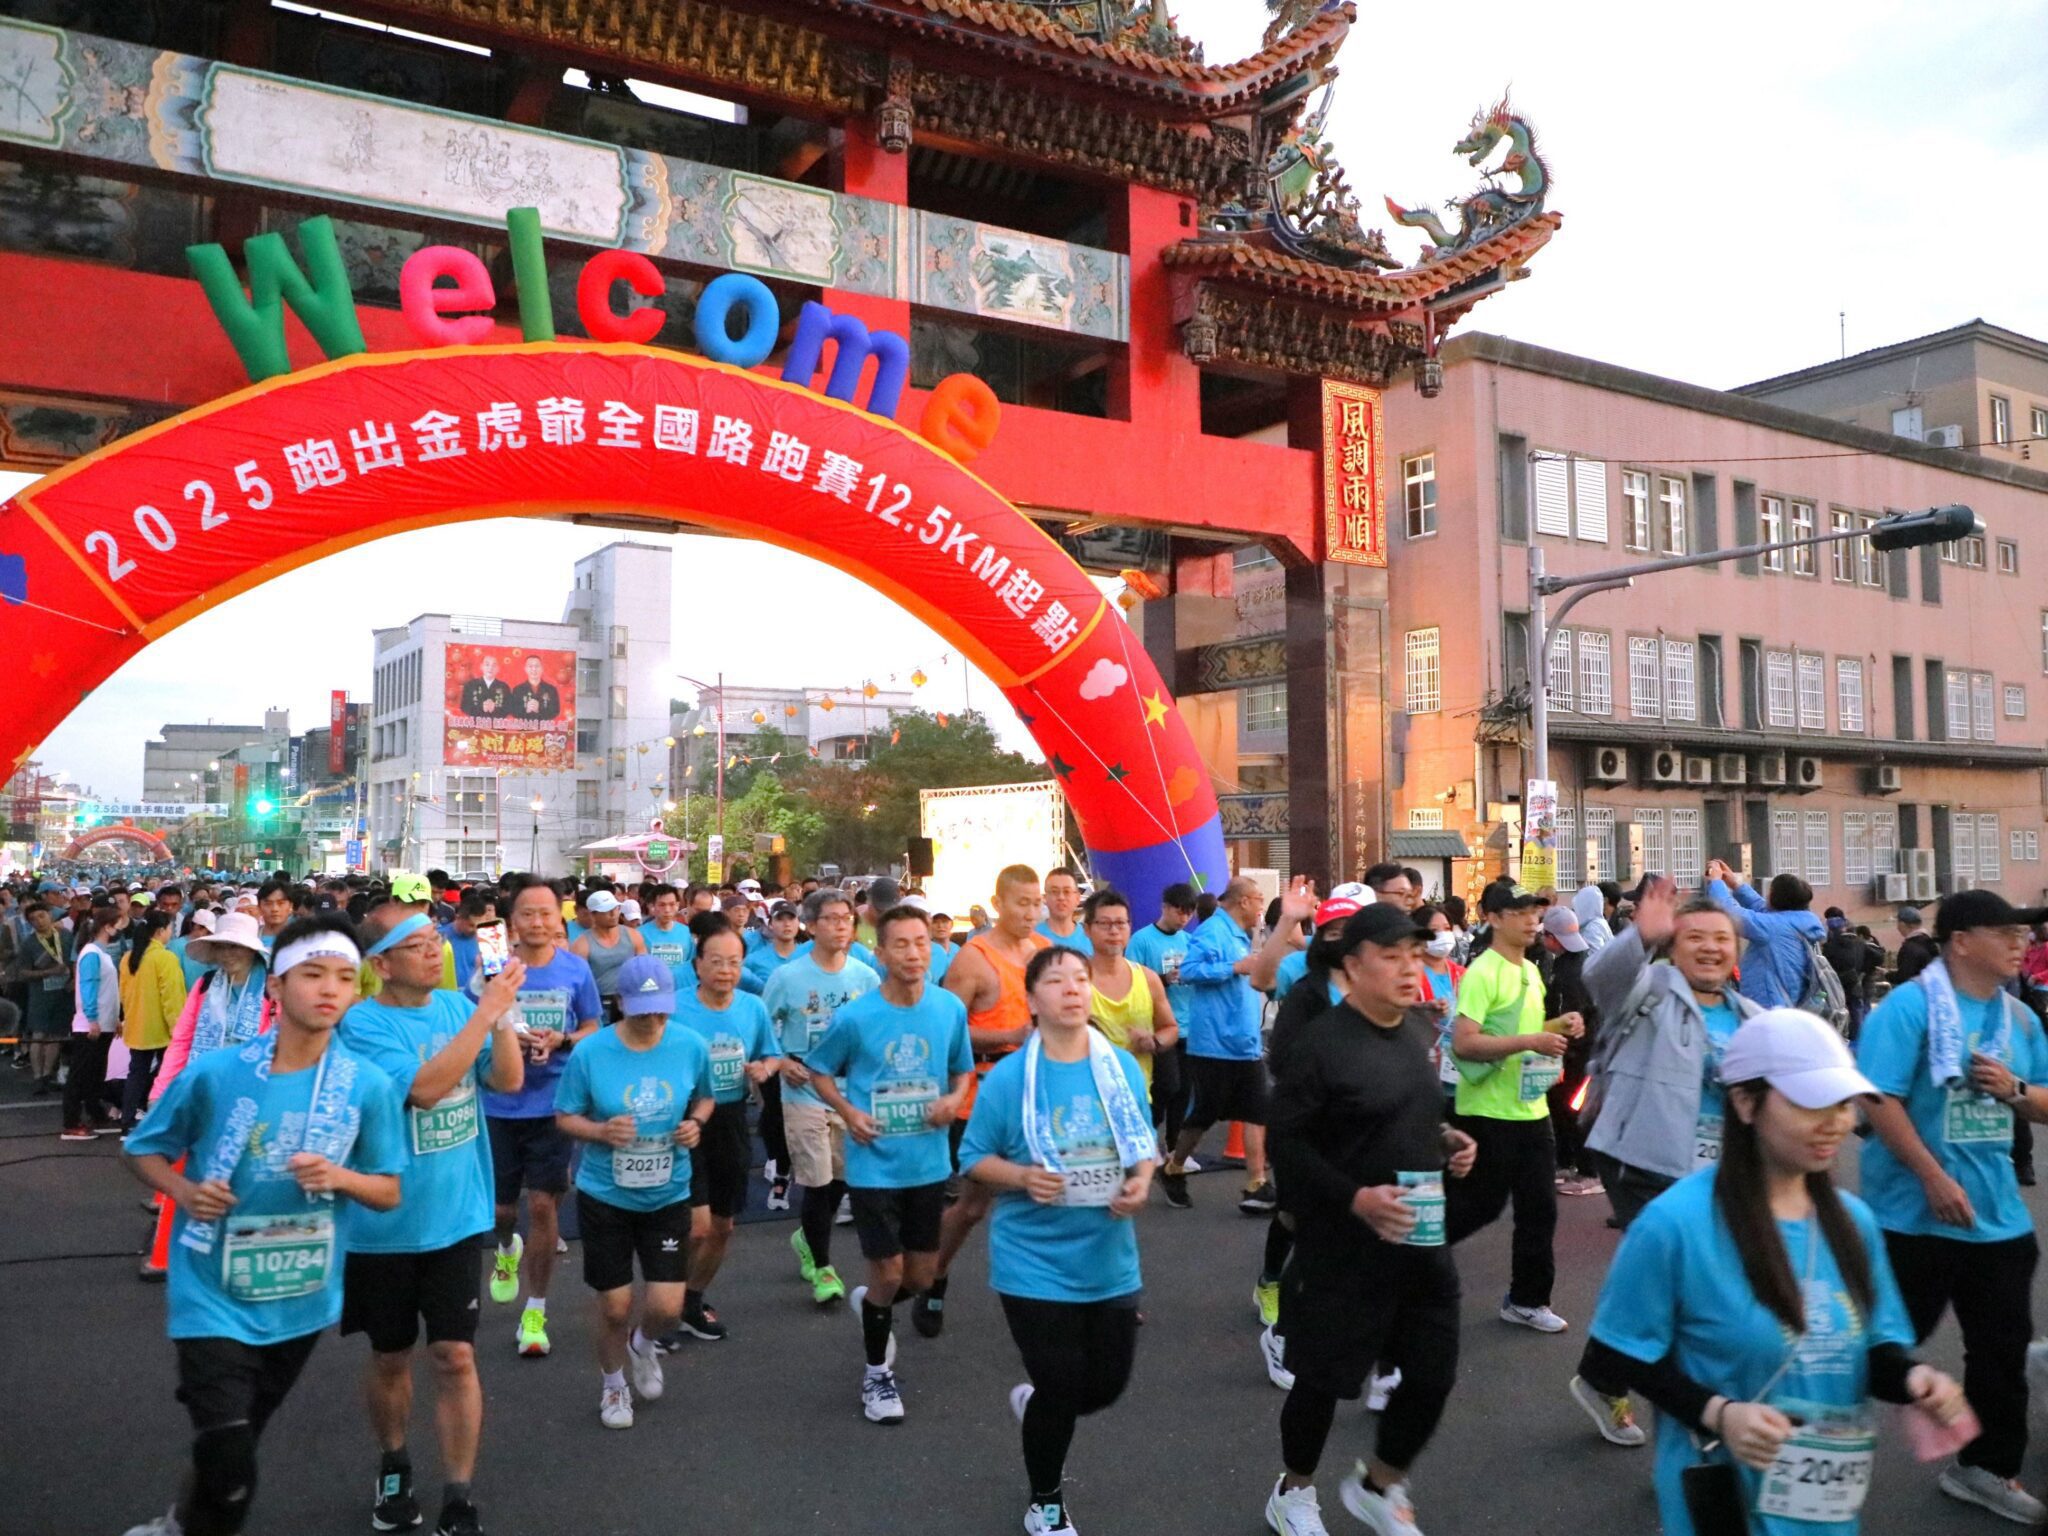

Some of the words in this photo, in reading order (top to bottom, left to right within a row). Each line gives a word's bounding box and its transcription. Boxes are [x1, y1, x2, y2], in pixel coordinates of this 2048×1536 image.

[1341, 401, 1371, 551] 風調雨順
[291, 745, 300, 791] Panasonic
[437, 1102, 475, 1129] 10986
[625, 1156, 671, 1172] 20212
[255, 1248, 325, 1273] 10784
